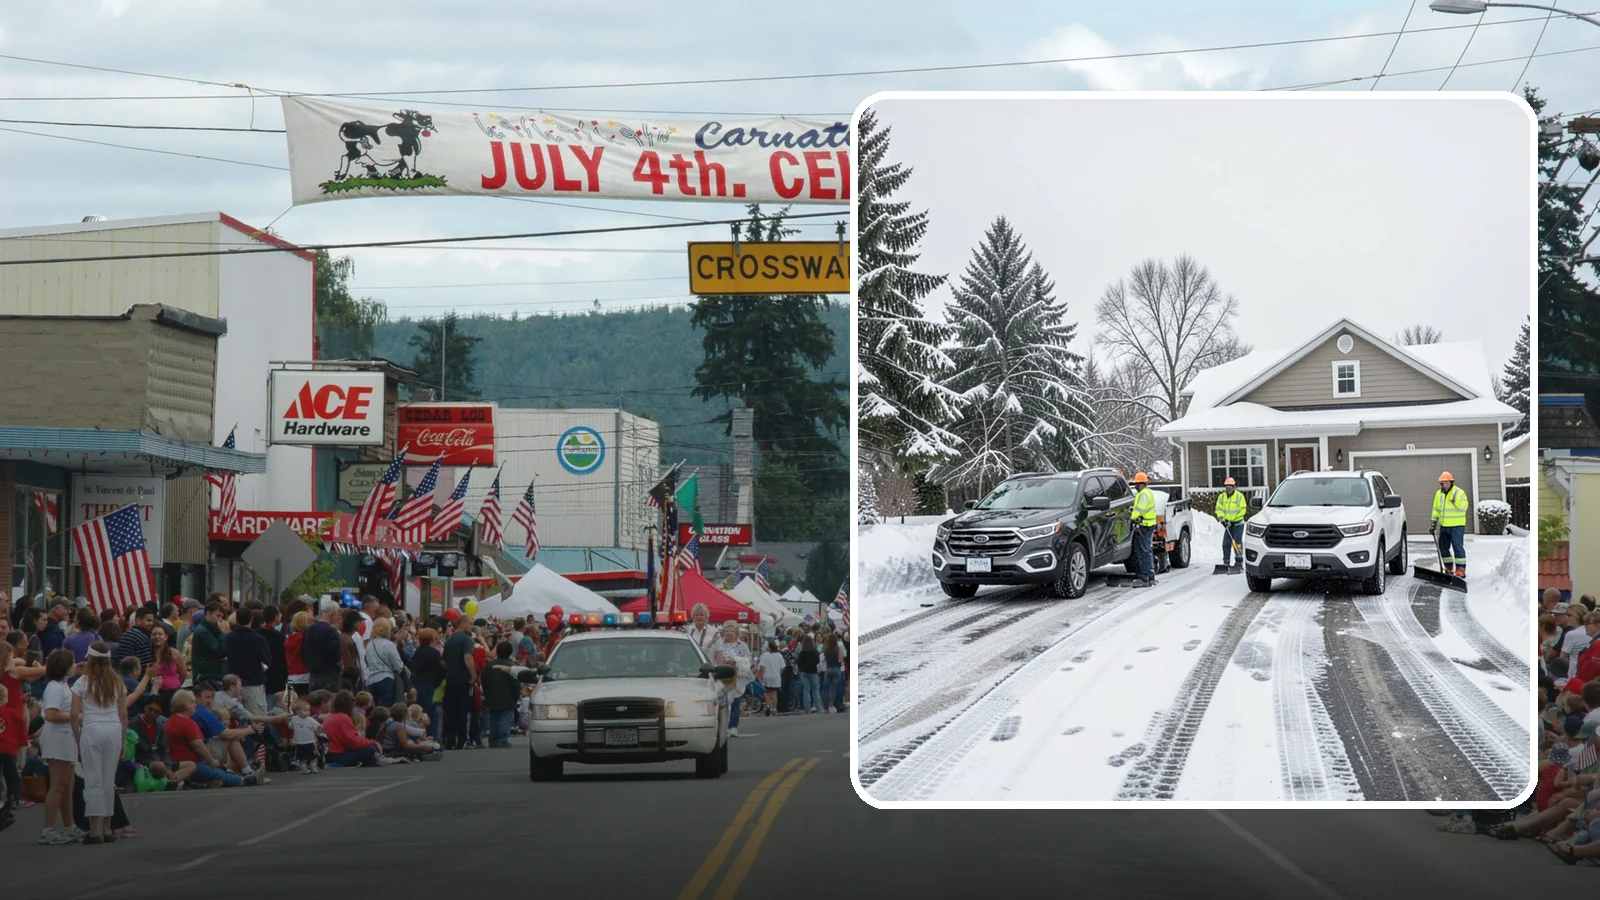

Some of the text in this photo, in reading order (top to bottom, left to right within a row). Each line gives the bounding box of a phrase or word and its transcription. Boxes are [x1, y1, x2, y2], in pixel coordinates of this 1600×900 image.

[481, 141, 605, 192] JULY
[632, 150, 746, 197] 4th.
[697, 254, 849, 280] CROSSWA
[282, 379, 374, 420] ACE
[405, 409, 485, 422] CEDAR LOG
[283, 421, 371, 437] Hardware
[416, 428, 477, 447] Coca-Cola
[83, 485, 155, 495] St. Vincent de Paul
[688, 526, 742, 535] CRNATION
[699, 535, 731, 543] GLASS
